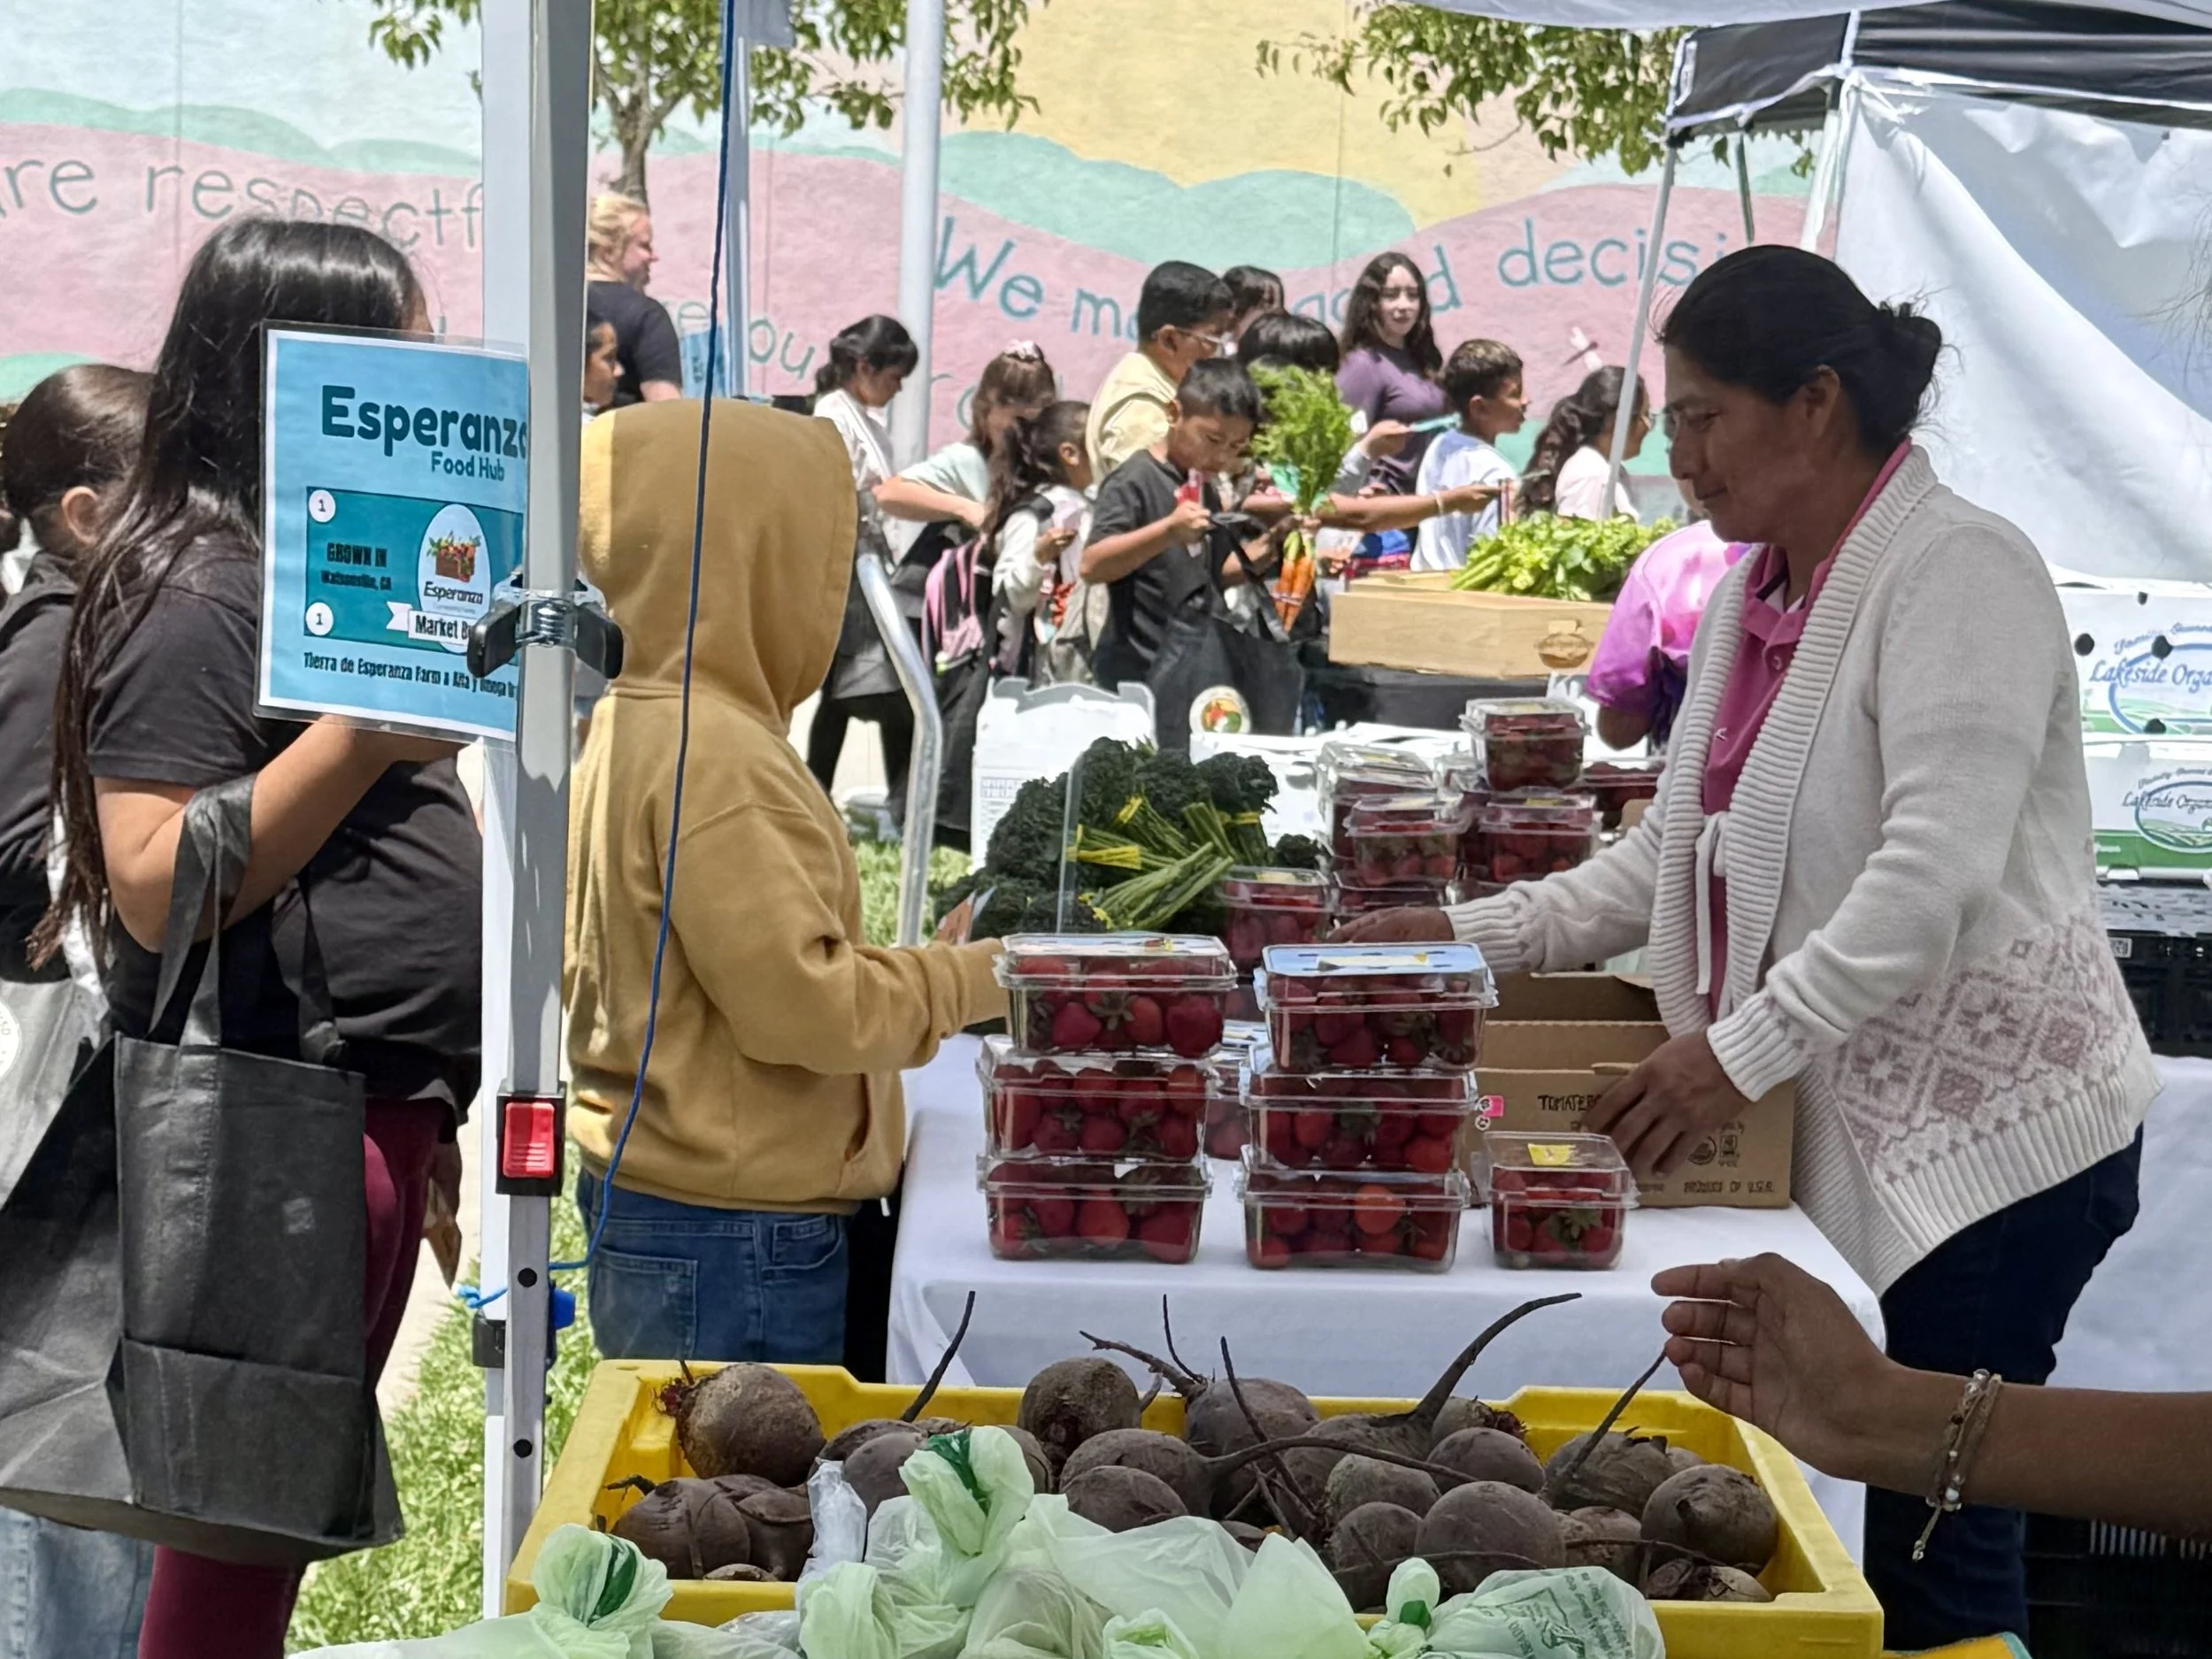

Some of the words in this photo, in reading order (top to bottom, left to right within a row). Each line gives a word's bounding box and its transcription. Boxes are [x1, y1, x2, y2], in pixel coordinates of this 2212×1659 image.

[0, 159, 97, 218] re
[933, 216, 1043, 319] We
[432, 450, 474, 478] Food
[479, 457, 505, 481] Hub
[318, 499, 326, 512] 1
[327, 542, 372, 566] GROWN
[375, 548, 388, 568] IN
[424, 581, 484, 605] Esperanza
[316, 613, 324, 626] 1
[415, 615, 458, 640] Market
[461, 620, 471, 641] B
[304, 652, 337, 672] Tierra
[341, 657, 354, 673] de
[357, 658, 413, 683] Esperanza
[415, 666, 441, 685] Farm
[2089, 657, 2168, 689] Lakeside
